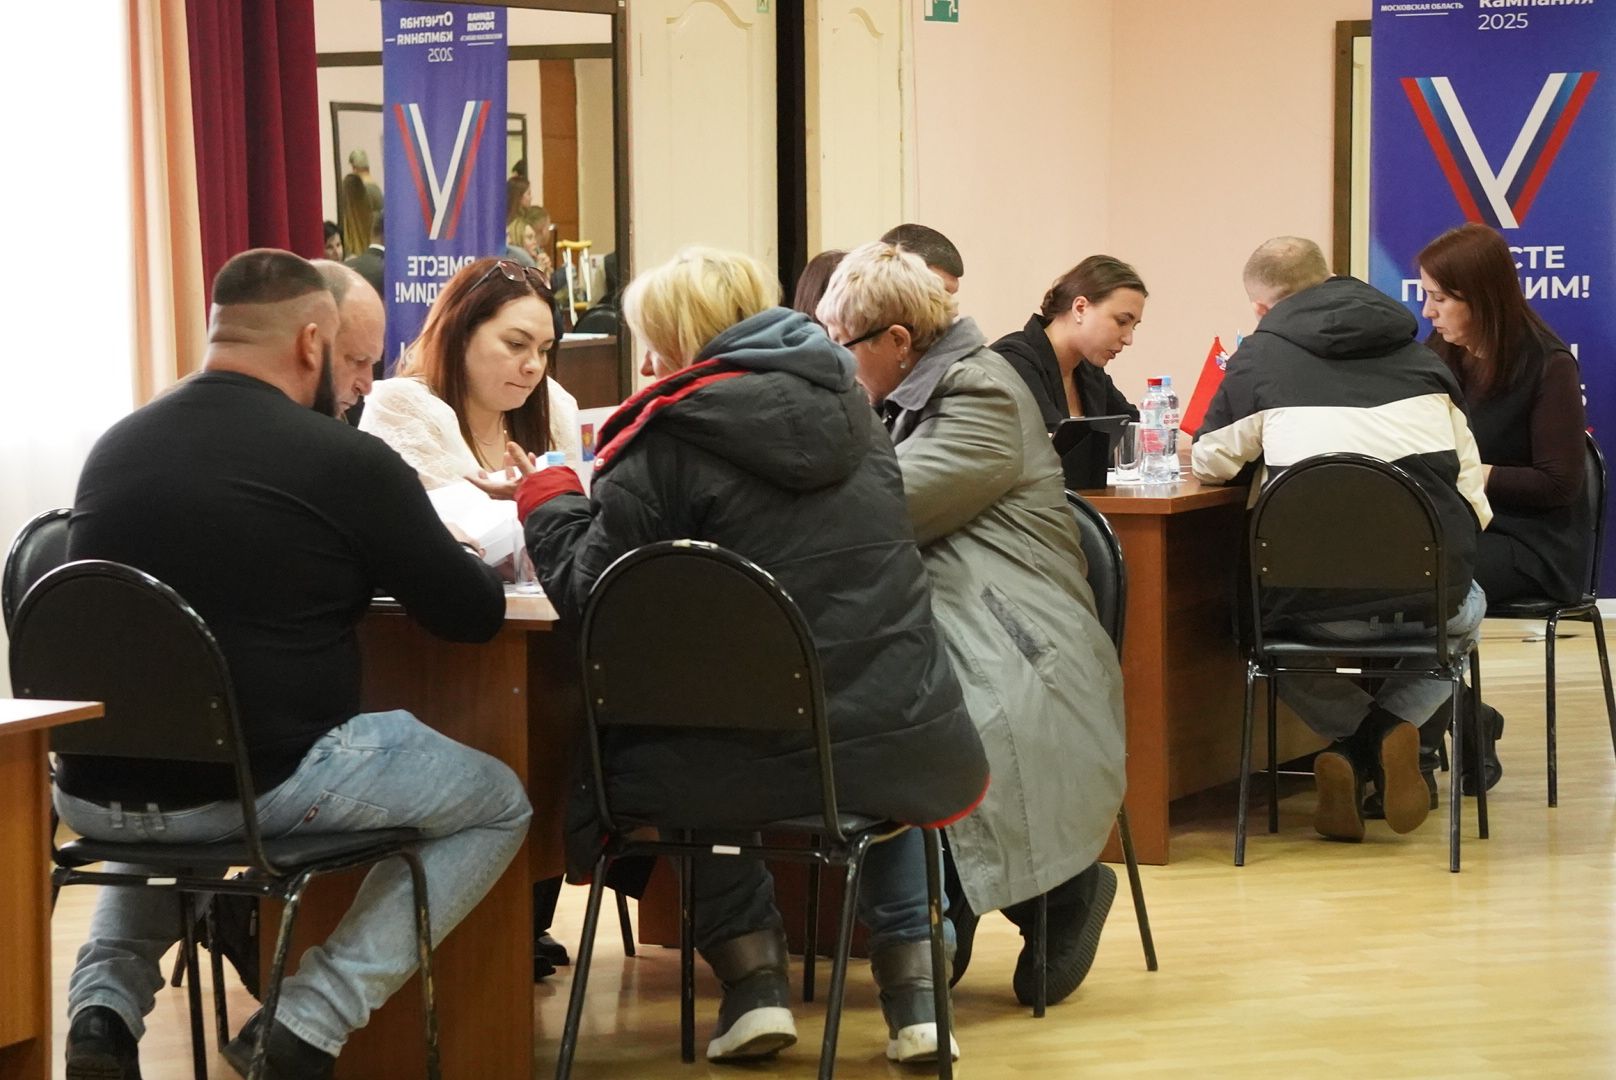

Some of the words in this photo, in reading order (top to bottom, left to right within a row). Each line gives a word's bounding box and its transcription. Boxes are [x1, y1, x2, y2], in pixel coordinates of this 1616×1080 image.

[1381, 4, 1430, 12] МОСКОВСКАЯ
[1431, 2, 1464, 10] ОБЛАСТЬ
[1478, 13, 1528, 30] 2025
